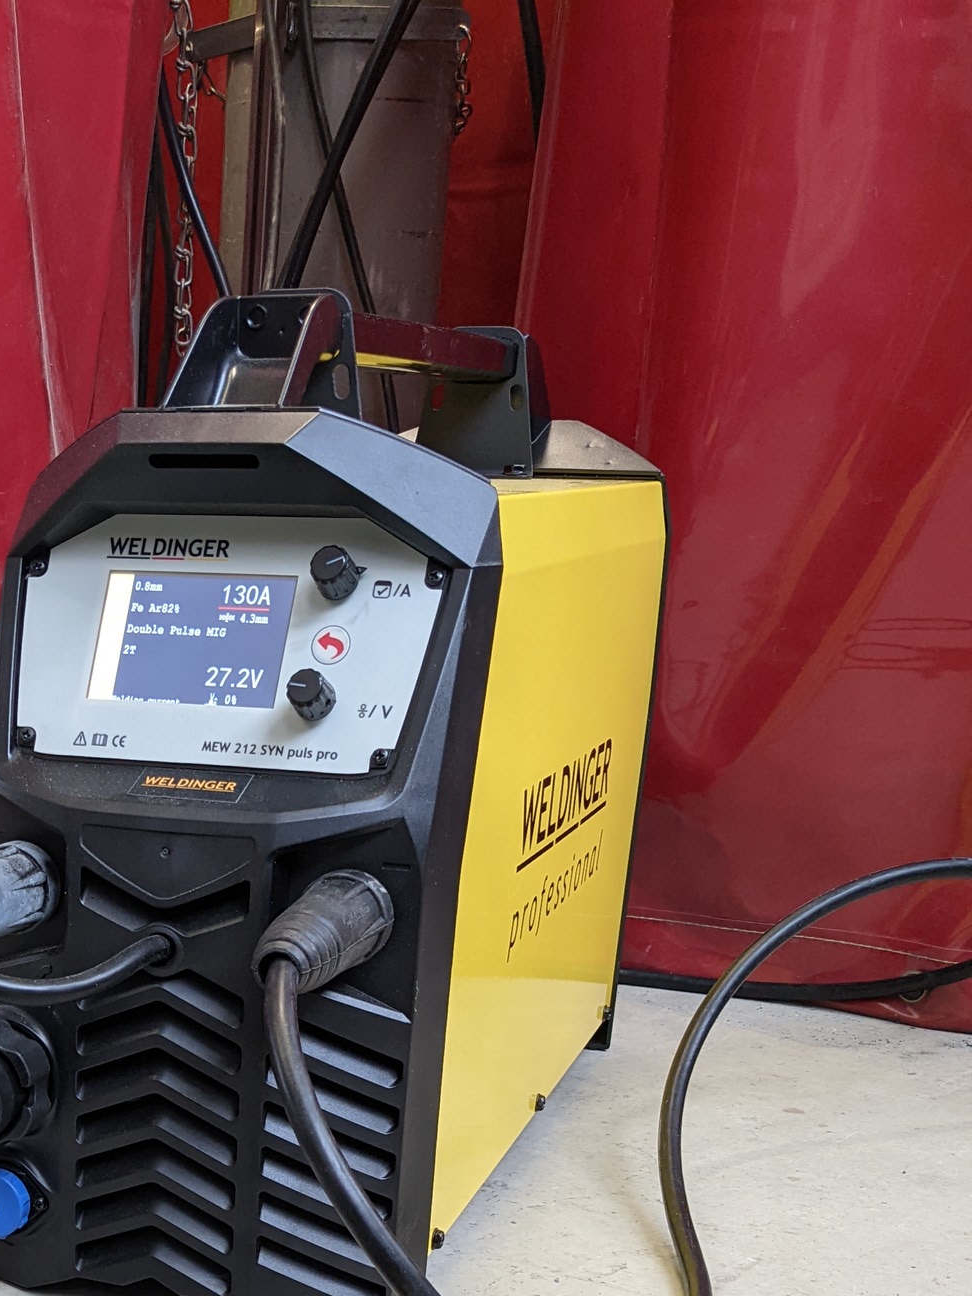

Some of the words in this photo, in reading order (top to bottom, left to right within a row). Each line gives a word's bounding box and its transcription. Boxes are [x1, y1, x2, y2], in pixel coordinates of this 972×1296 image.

[110, 537, 230, 558] WELDINGER
[135, 581, 163, 592] 0.8mm
[222, 584, 271, 606] 130A
[131, 602, 145, 613] Fe
[148, 603, 181, 614] Ar82%
[239, 613, 269, 625] 4.3mm
[126, 624, 165, 635] Double
[169, 625, 202, 637] Pulse
[205, 627, 227, 638] MIG
[123, 644, 137, 655] 2T
[204, 667, 264, 689] 27.2V
[201, 740, 231, 753] MEW
[234, 743, 257, 755] 212
[260, 744, 285, 757] SYN
[287, 747, 313, 760] puls
[316, 750, 339, 762] pro
[144, 775, 237, 791] WELDINGER
[521, 738, 613, 856] WELDINGER
[506, 828, 604, 964] professional
